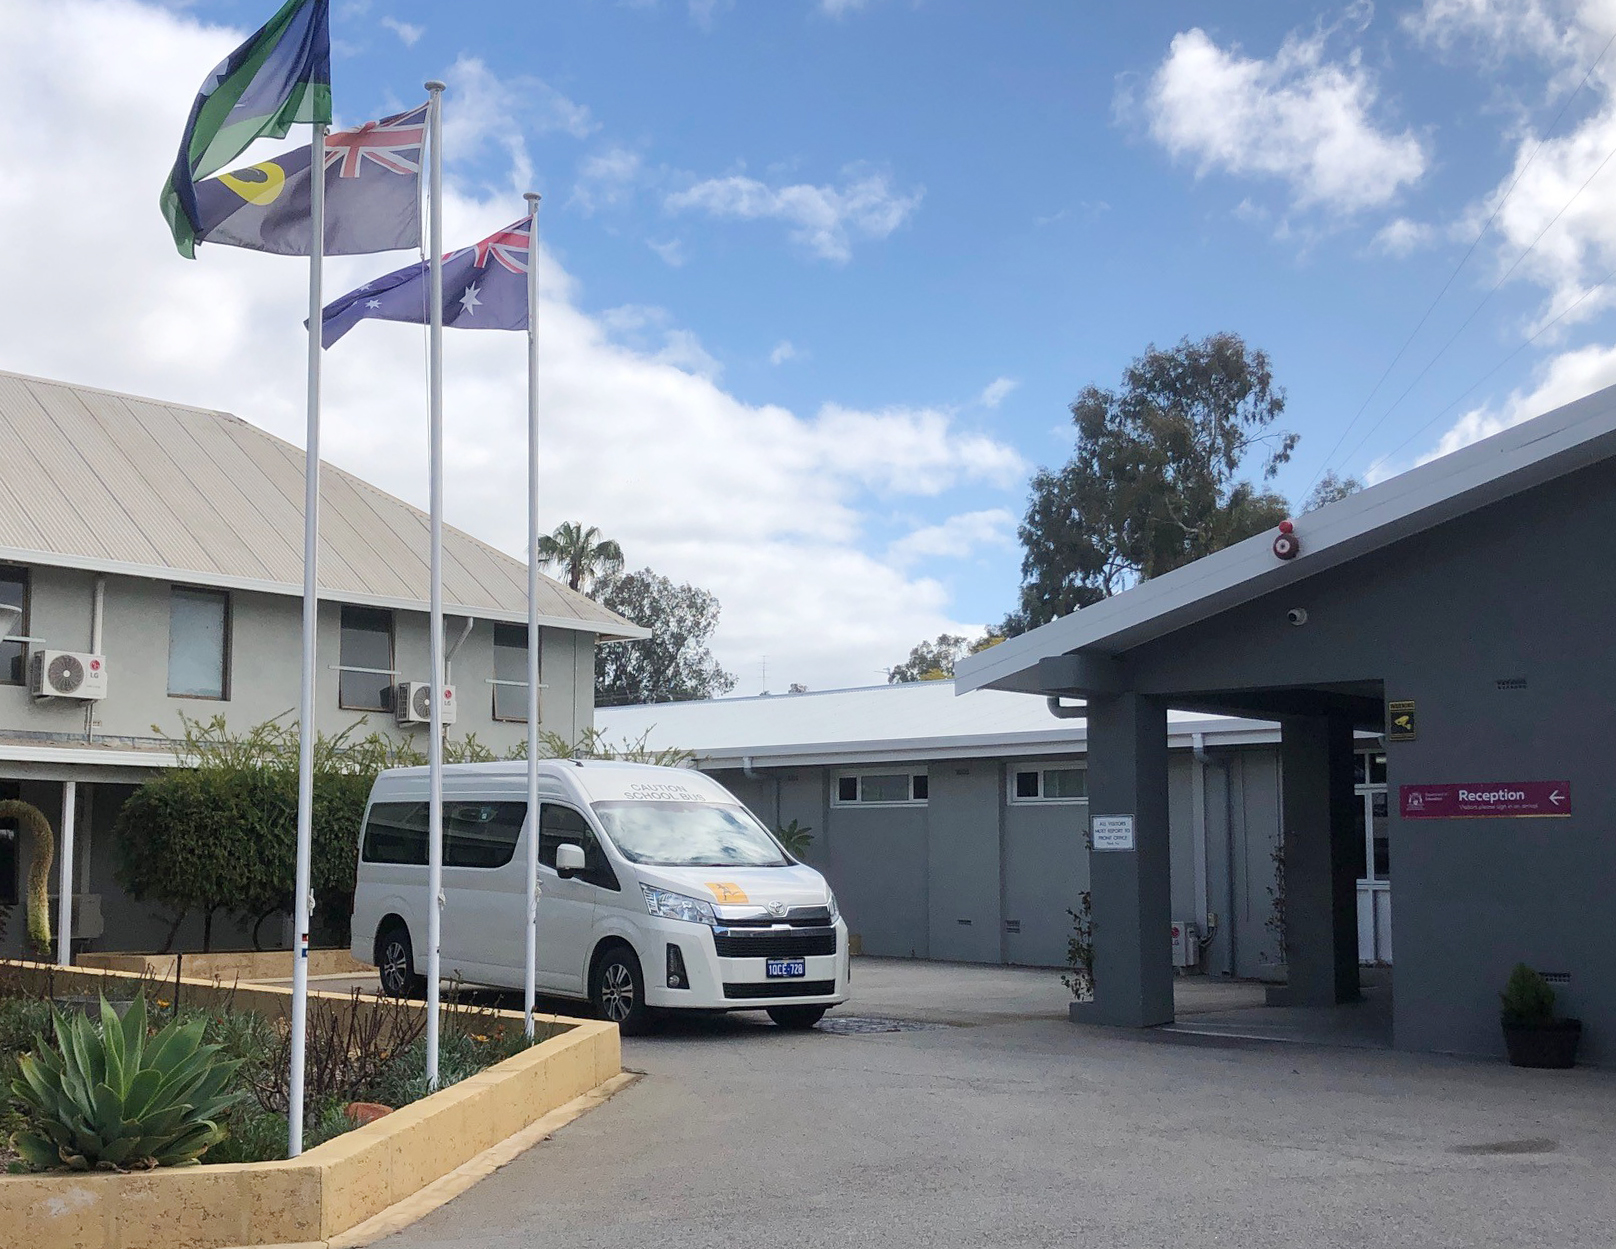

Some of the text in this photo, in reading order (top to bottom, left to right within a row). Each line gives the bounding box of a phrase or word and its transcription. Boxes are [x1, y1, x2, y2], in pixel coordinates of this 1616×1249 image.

[630, 783, 688, 793] CAUTION
[624, 792, 706, 802] SCHOOL BUS
[1458, 789, 1525, 804] Reception
